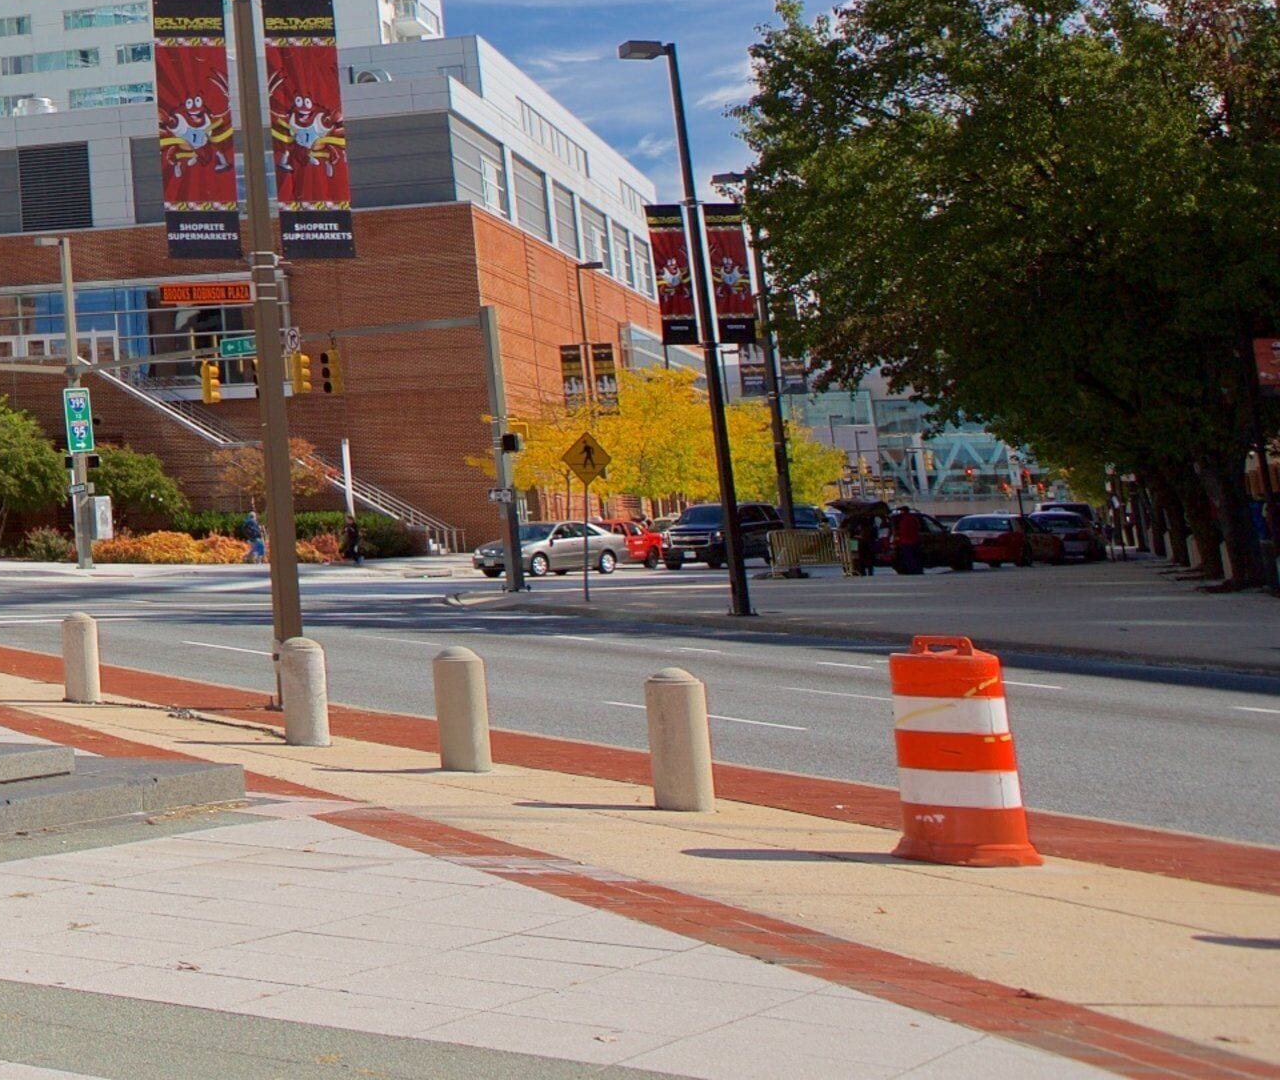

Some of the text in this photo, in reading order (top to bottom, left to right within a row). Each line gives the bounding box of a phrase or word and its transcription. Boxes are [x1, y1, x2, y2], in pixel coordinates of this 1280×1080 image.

[154, 17, 223, 26] BALTIMORE
[265, 17, 333, 26] BALTIMORE
[179, 223, 225, 232] SHOPRITE
[294, 223, 339, 232] SHOPRITE
[168, 232, 238, 241] SUPERMARKETS
[283, 232, 353, 241] SUPERMARKETS
[163, 285, 250, 301] BROOKS ROBINSON PLAZA
[73, 426, 87, 438] 95
